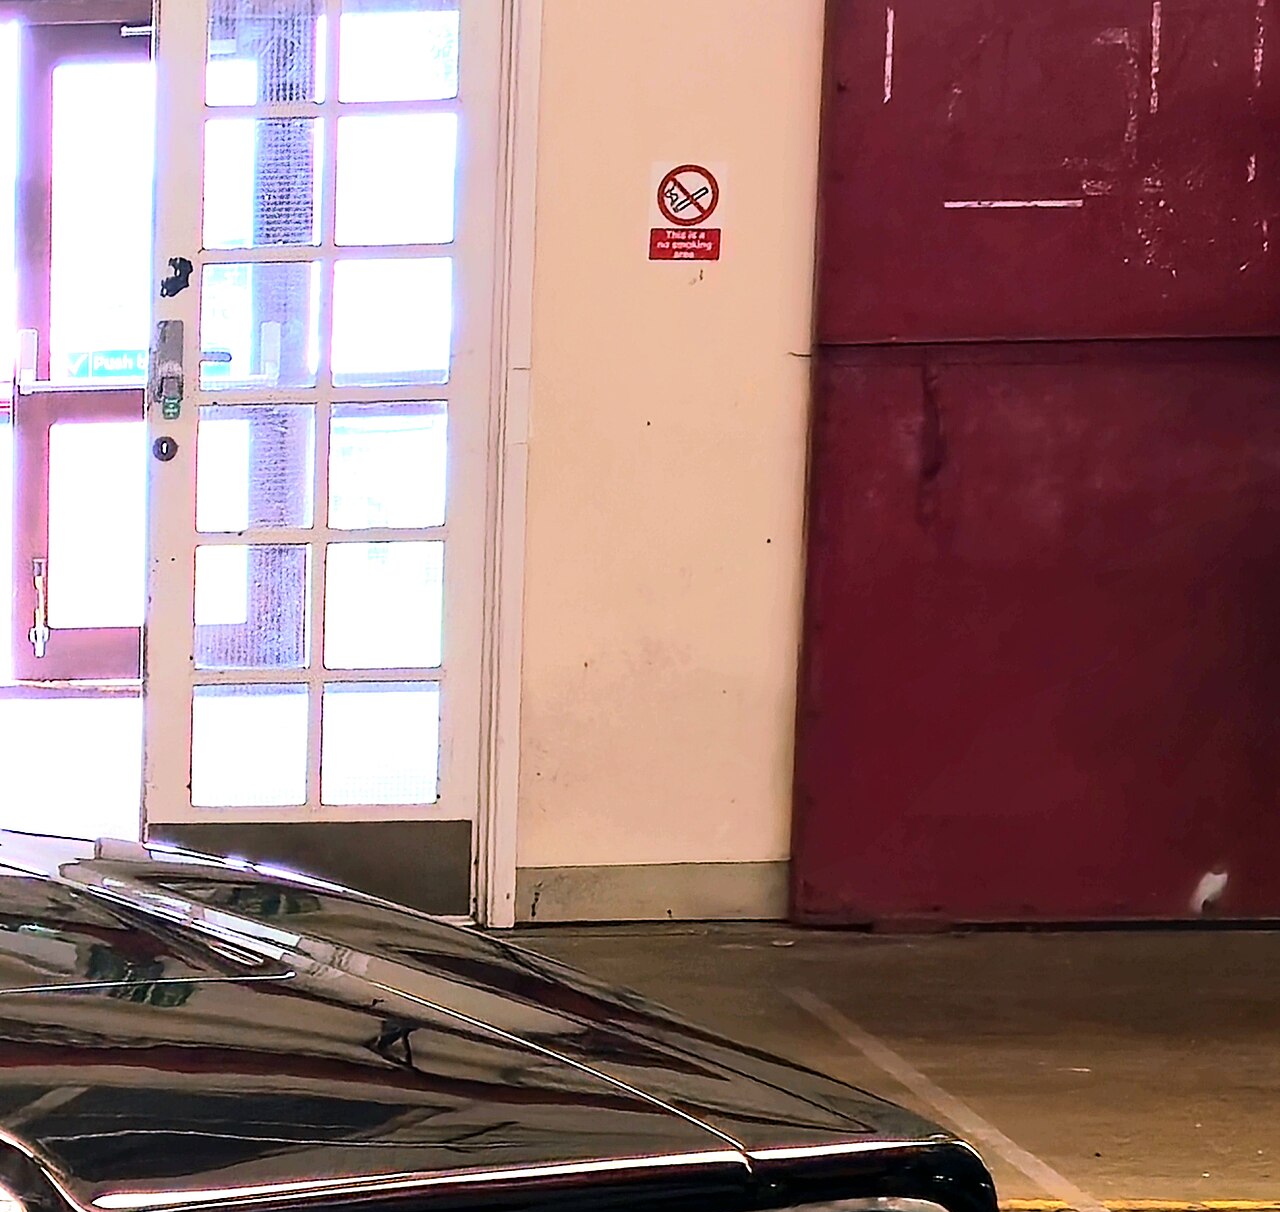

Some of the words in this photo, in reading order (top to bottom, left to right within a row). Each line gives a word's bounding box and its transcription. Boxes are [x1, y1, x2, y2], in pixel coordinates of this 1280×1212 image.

[665, 230, 686, 239] This
[656, 241, 670, 249] no
[671, 240, 713, 251] smoking
[673, 251, 695, 259] area
[93, 354, 134, 371] Push
